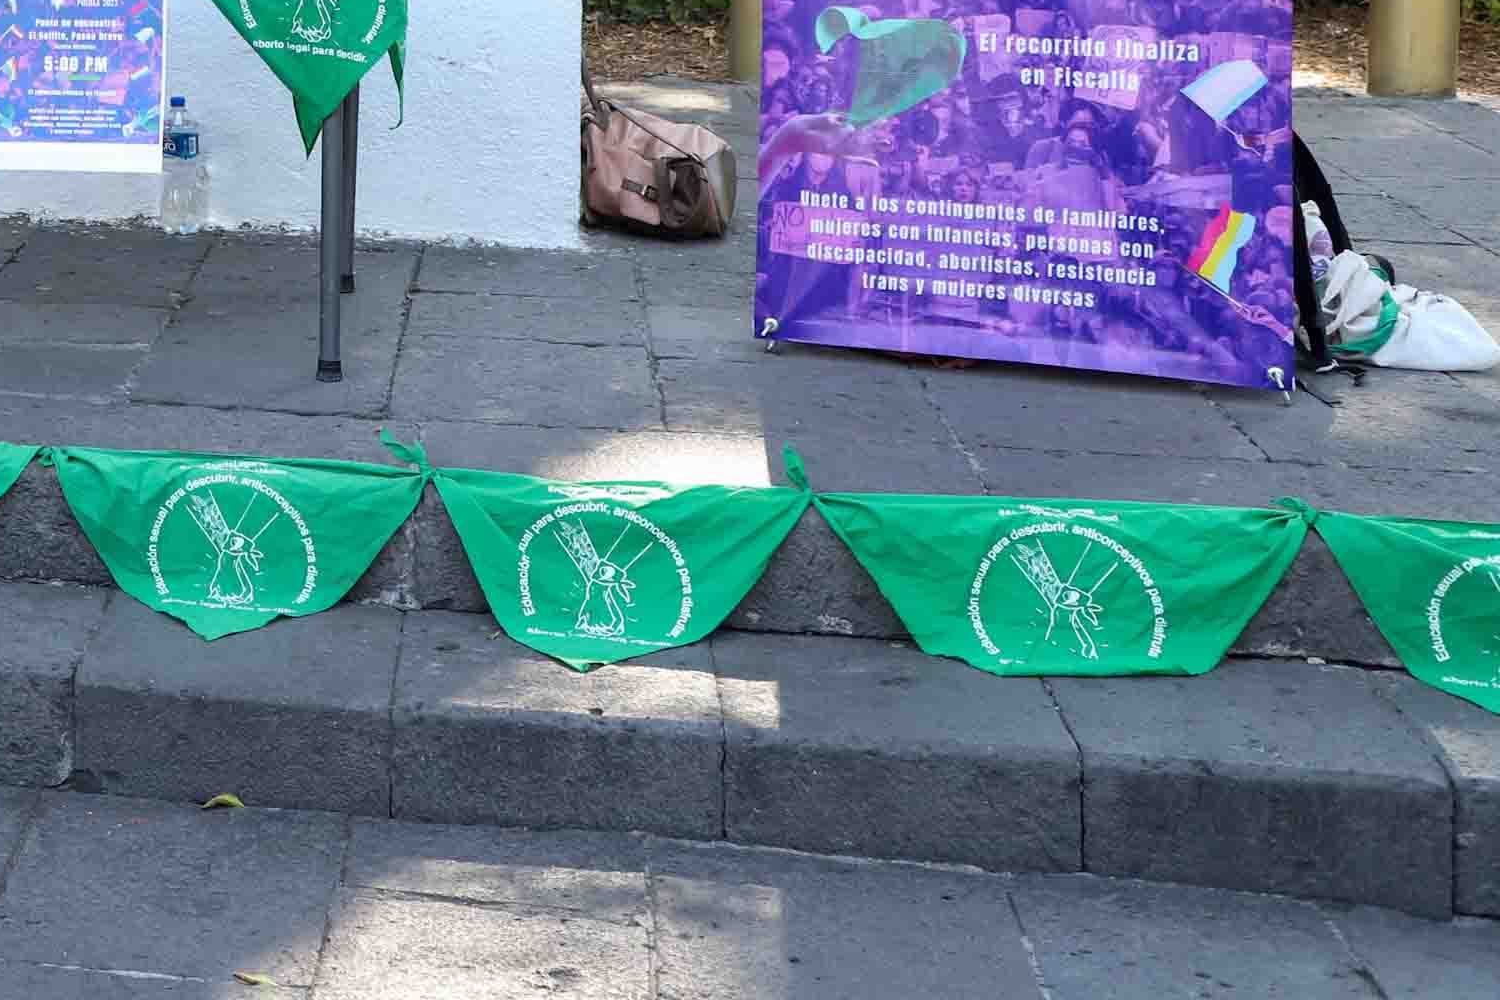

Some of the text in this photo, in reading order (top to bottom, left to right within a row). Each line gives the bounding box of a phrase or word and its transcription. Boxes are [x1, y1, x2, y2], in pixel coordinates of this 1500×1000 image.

[43, 55, 109, 73] 5:00 PM
[253, 38, 285, 49] aborto
[286, 41, 311, 53] legal
[312, 46, 334, 57] para
[979, 33, 1199, 62] El recorrido finaliza
[1020, 67, 1045, 86] en
[855, 196, 865, 211] a
[872, 193, 899, 213] los
[905, 198, 1026, 223] contingentes
[1033, 204, 1055, 225] de
[1061, 207, 1165, 235] familiares,
[810, 217, 1155, 260] mujeres con infancias, personas con
[806, 241, 1157, 287] discapacidad, abortistas, resistencia
[862, 271, 1095, 308] trans y mujeres diversas
[149, 506, 168, 543] sexual
[165, 487, 186, 511] para
[241, 476, 309, 536] anticonceptivos
[300, 536, 317, 563] para
[517, 554, 536, 616] Educación
[531, 511, 555, 535] para
[554, 501, 610, 519] descubrir,
[613, 506, 685, 567] anticonceptivos
[676, 567, 692, 595] para
[970, 556, 990, 597] sexual
[987, 536, 1011, 560] para
[1010, 522, 1068, 540] descubrir,
[1072, 524, 1154, 587] anticonceptivos
[1145, 587, 1164, 616] para
[1434, 565, 1465, 597] sexual
[1425, 598, 1451, 663] Educación
